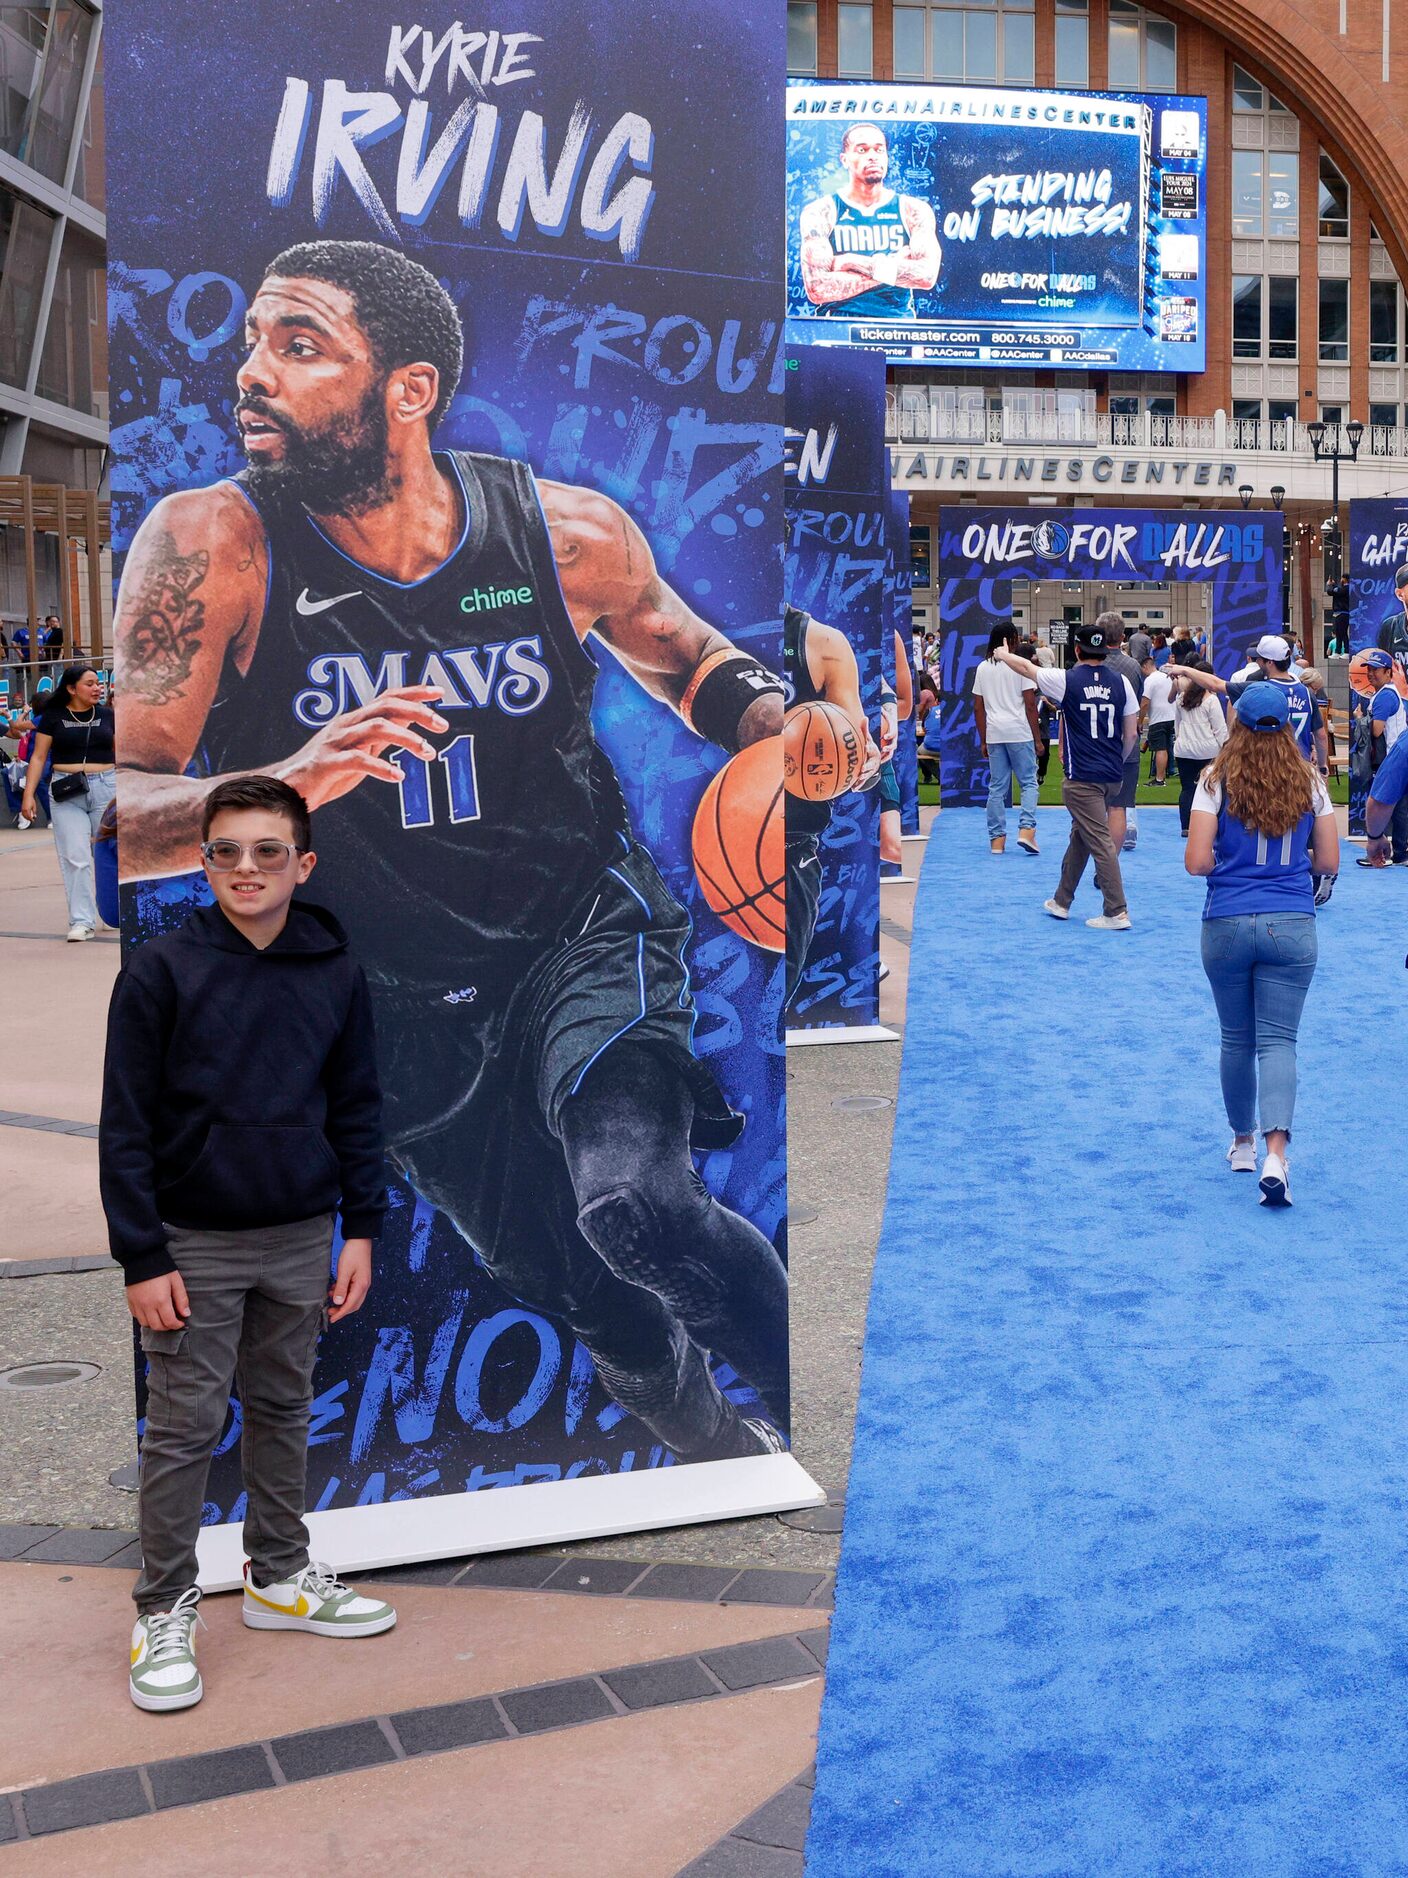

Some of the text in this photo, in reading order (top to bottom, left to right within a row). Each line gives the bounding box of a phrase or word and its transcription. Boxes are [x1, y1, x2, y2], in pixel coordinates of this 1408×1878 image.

[385, 20, 544, 98] KYRIE
[267, 76, 656, 262] IRVING
[1165, 187, 1194, 195] MAY 08
[943, 201, 1132, 243] ON BUSINESS!
[981, 271, 1009, 292] ONE
[1020, 272, 1050, 292] FOR
[1038, 295, 1075, 308] chime
[513, 295, 785, 395] PROU
[860, 328, 1075, 345] ticketmaster.com 800.745.3000
[961, 518, 1231, 573] ONE FOR ALL
[459, 586, 533, 614] chime
[292, 635, 551, 729] MAVS
[1080, 703, 1116, 739] 77
[1288, 712, 1309, 740] 7
[389, 735, 481, 829] 11
